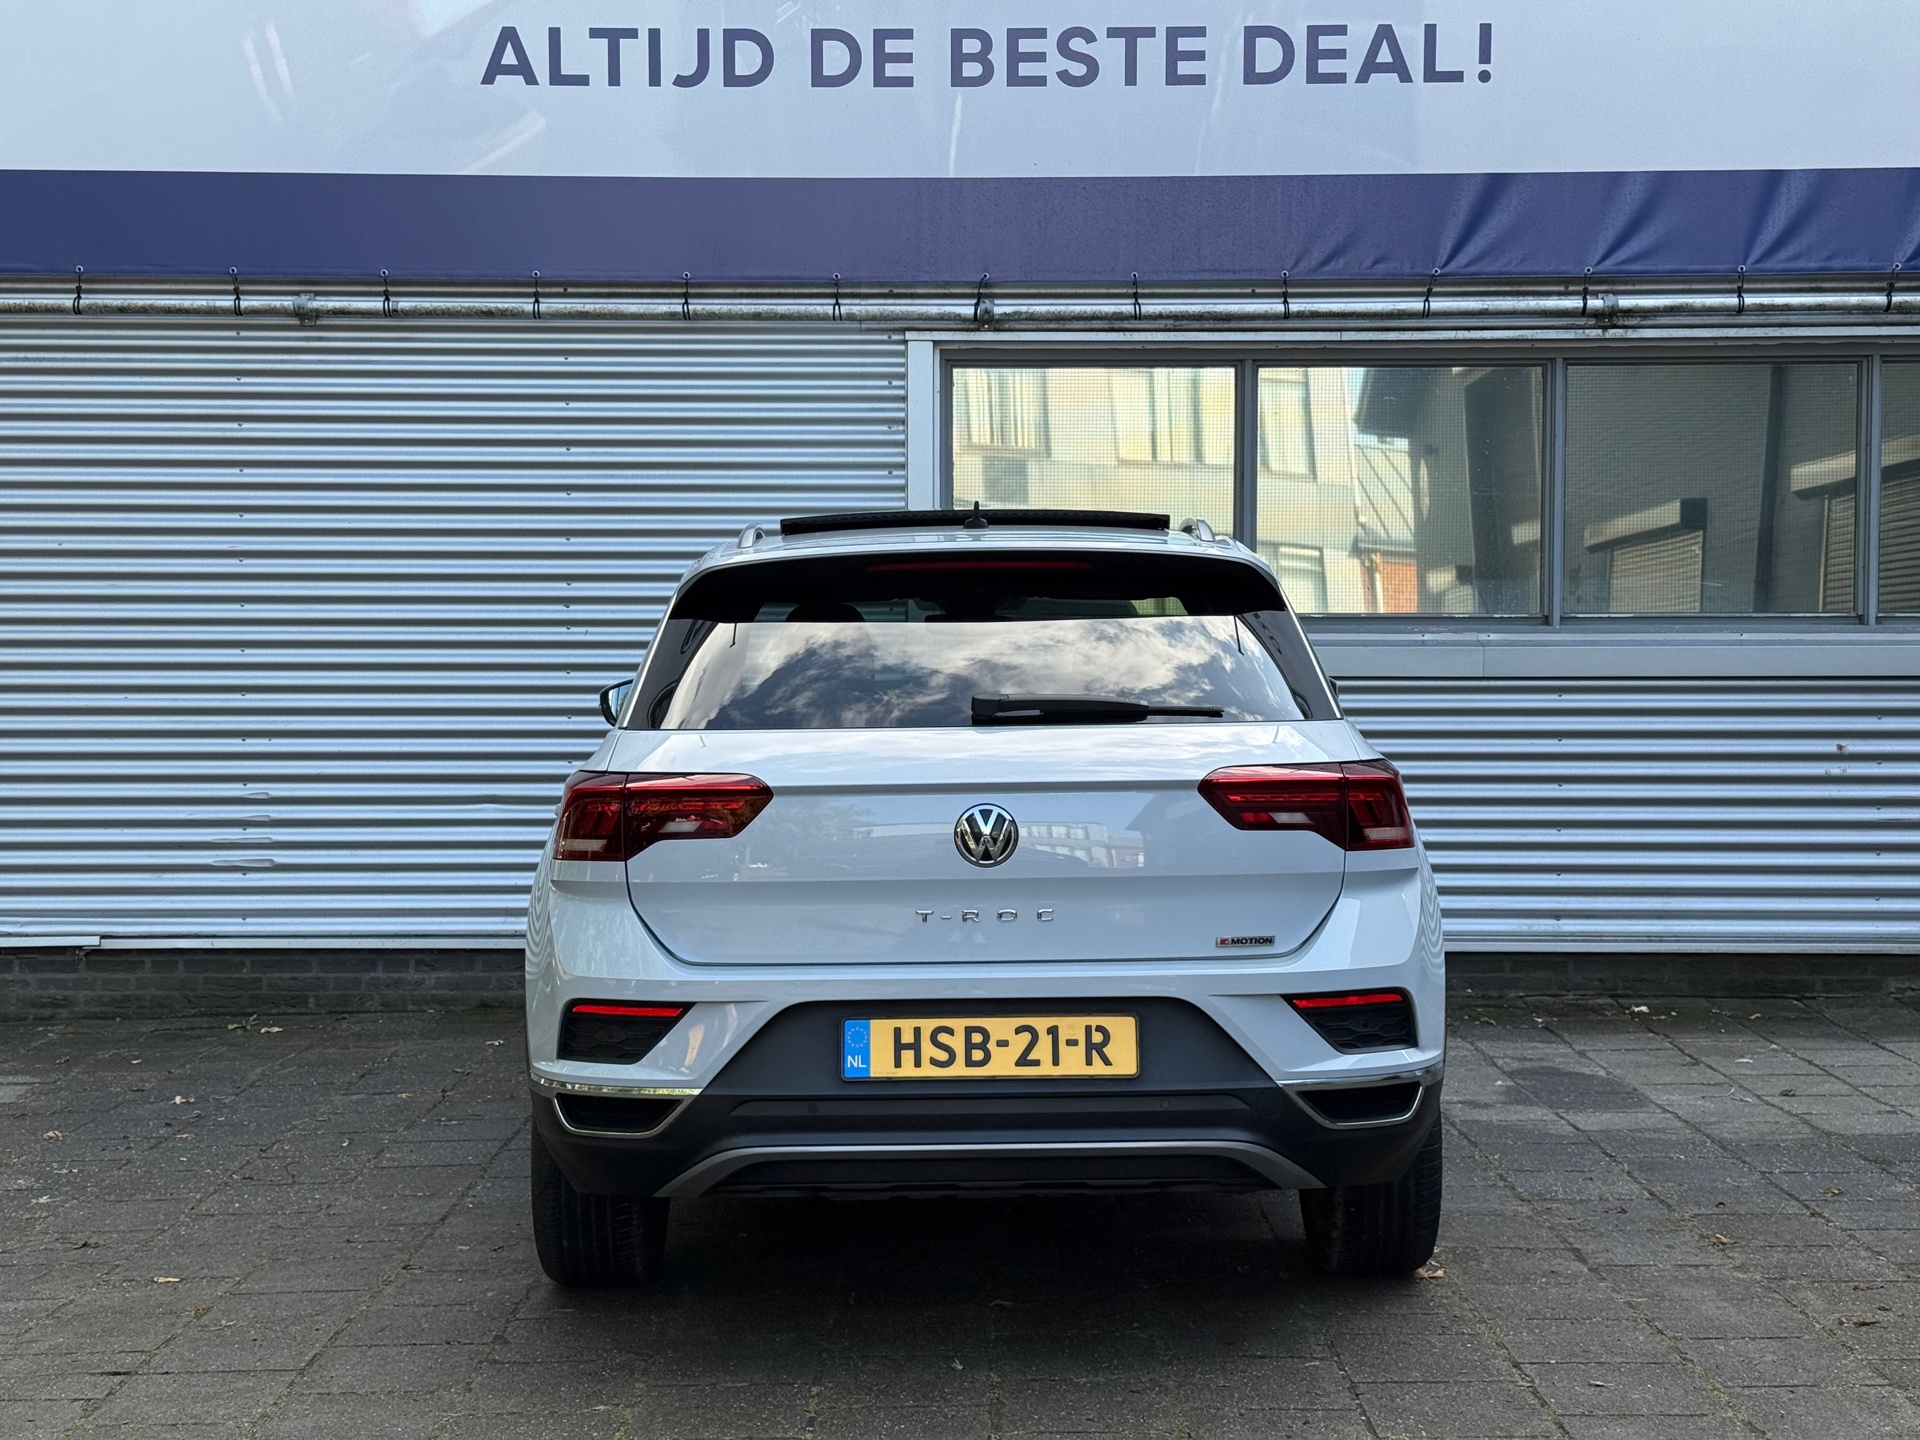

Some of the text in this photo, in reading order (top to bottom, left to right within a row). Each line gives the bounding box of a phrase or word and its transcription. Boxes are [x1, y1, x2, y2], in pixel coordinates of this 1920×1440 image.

[480, 22, 1492, 88] ALTIJD DE BESTE DEAL!
[915, 908, 1054, 923] T-ROC
[847, 1054, 867, 1068] NL
[893, 1024, 1113, 1069] HSB-21-R
